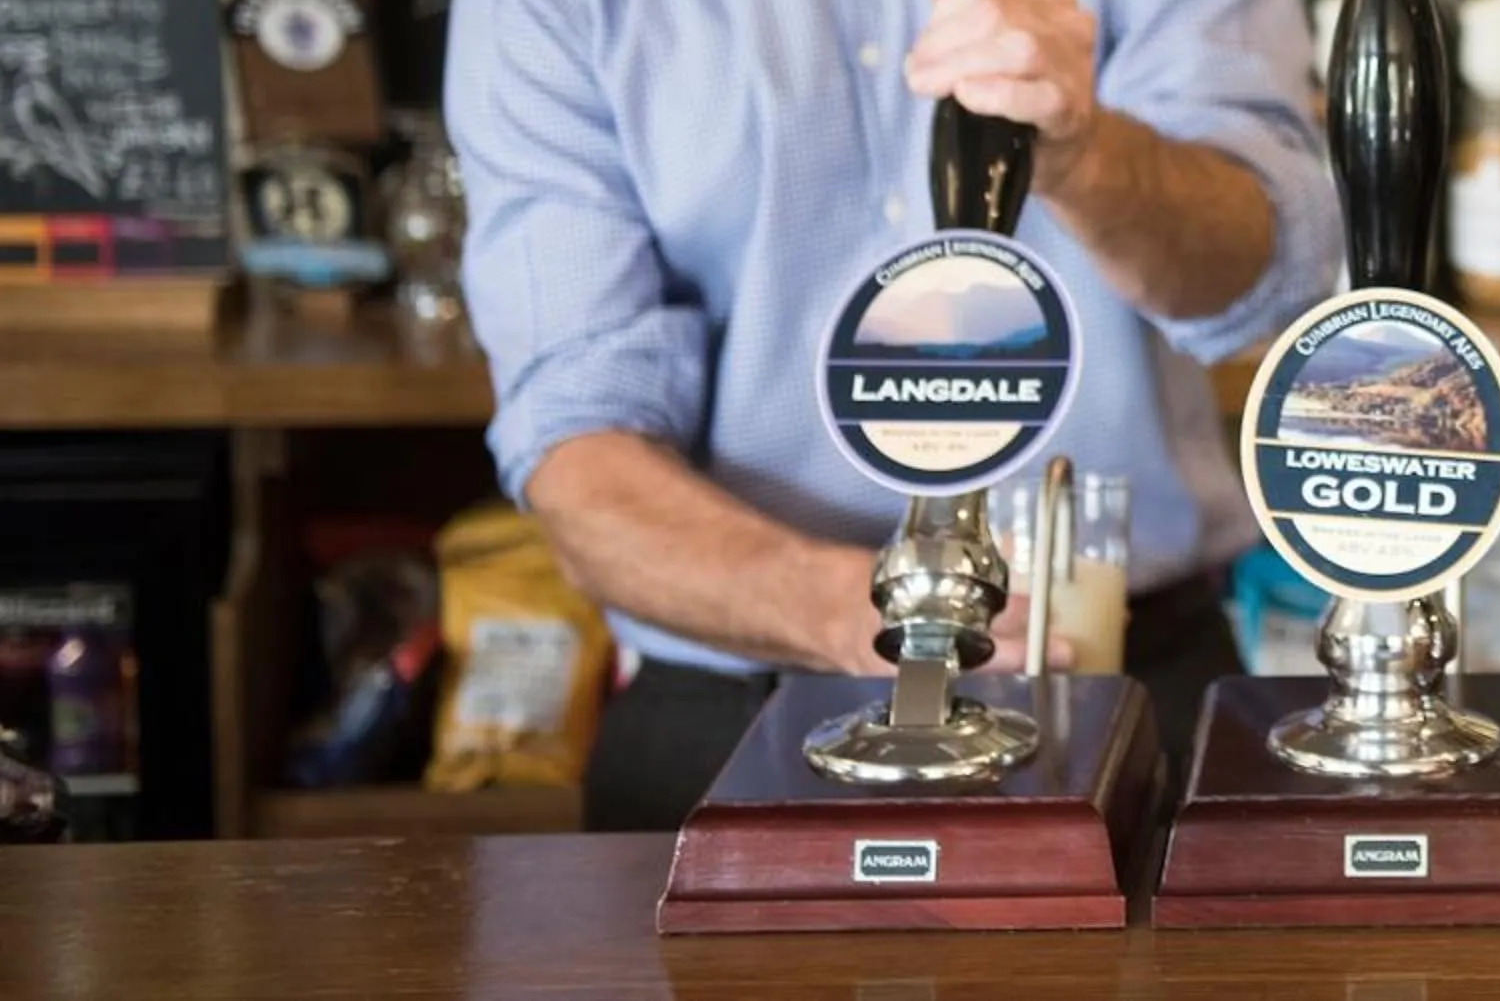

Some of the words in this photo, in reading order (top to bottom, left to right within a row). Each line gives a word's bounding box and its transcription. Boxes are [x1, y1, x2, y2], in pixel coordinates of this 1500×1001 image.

[1295, 304, 1368, 356] CUMBRIAN
[1369, 301, 1457, 339] LEGENDARY
[1451, 337, 1485, 370] ALES
[852, 373, 1042, 403] LANGDALE
[1286, 449, 1477, 481] LOWESWATER
[1301, 474, 1457, 516] GOLD
